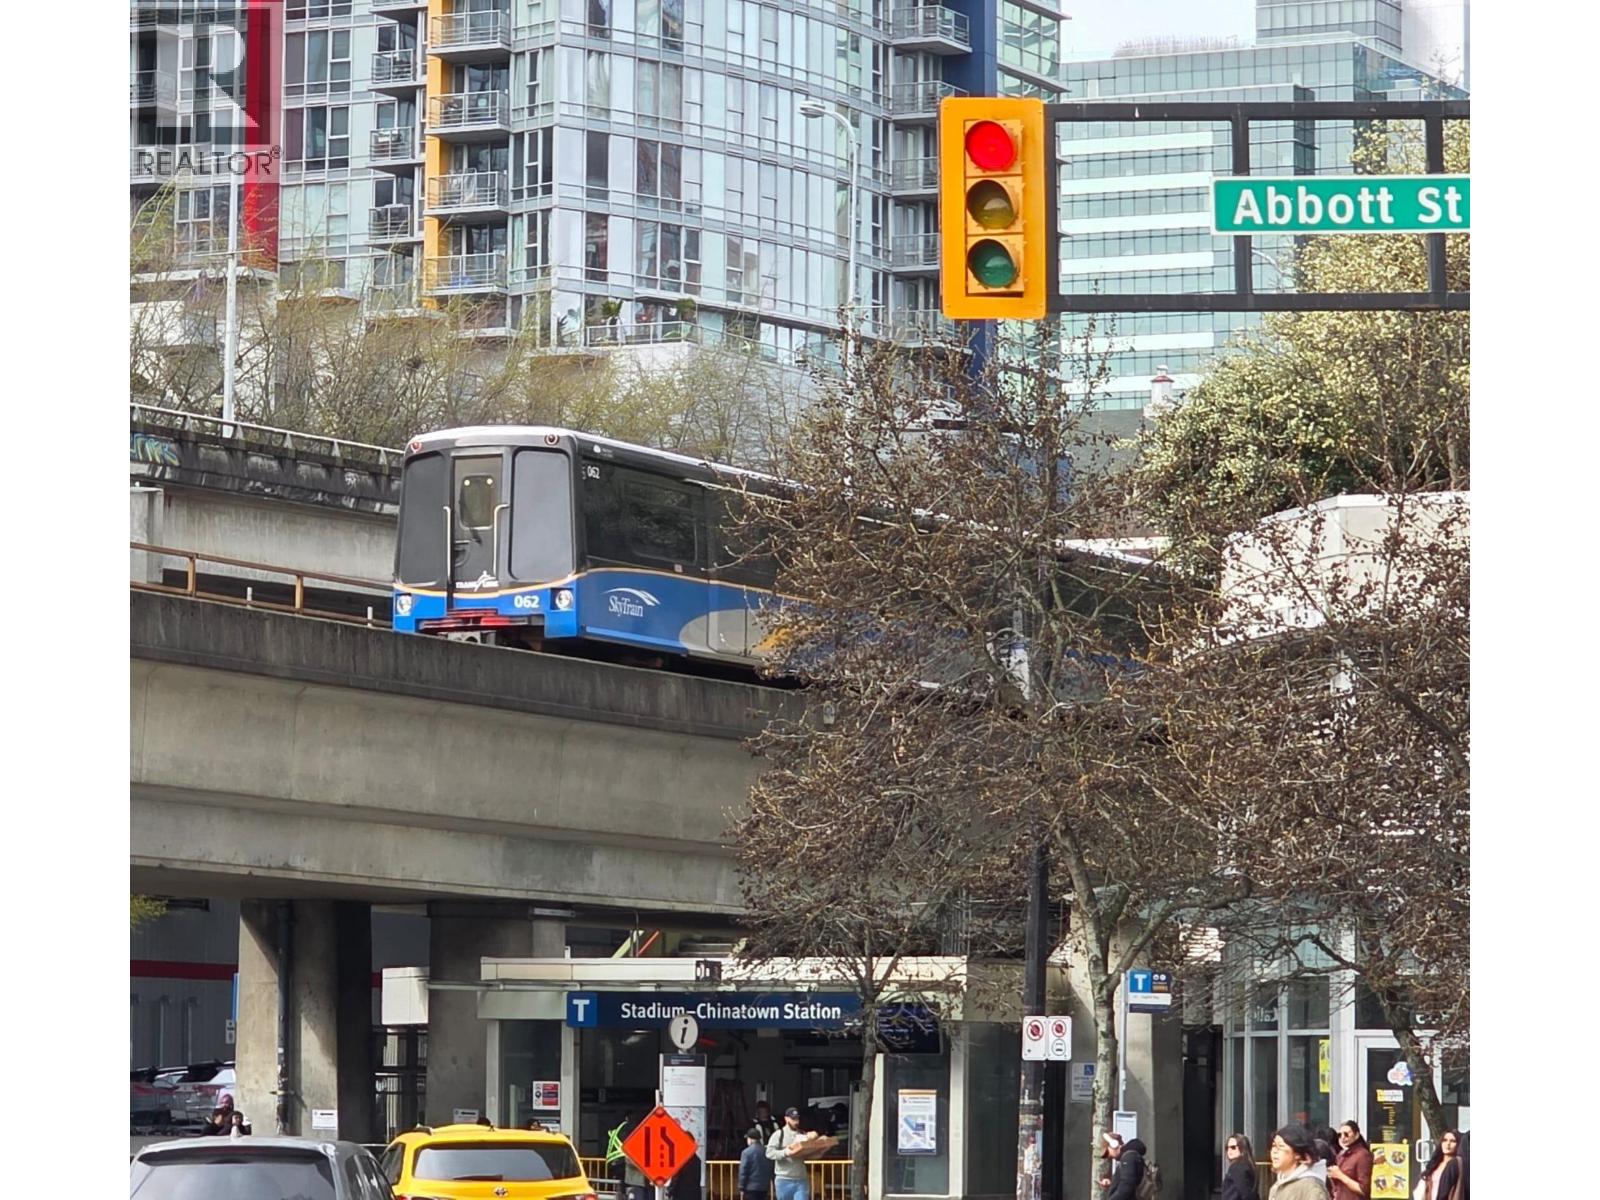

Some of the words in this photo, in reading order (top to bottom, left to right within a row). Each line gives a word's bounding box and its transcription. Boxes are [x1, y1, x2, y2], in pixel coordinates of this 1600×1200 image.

[1232, 185, 1395, 226] Abbott
[1416, 186, 1463, 225] St
[587, 465, 600, 479] 062
[513, 594, 540, 609] 062
[608, 595, 644, 618] SkyTrain
[1133, 973, 1148, 991] T
[572, 999, 590, 1022] T
[783, 1002, 841, 1020] Station
